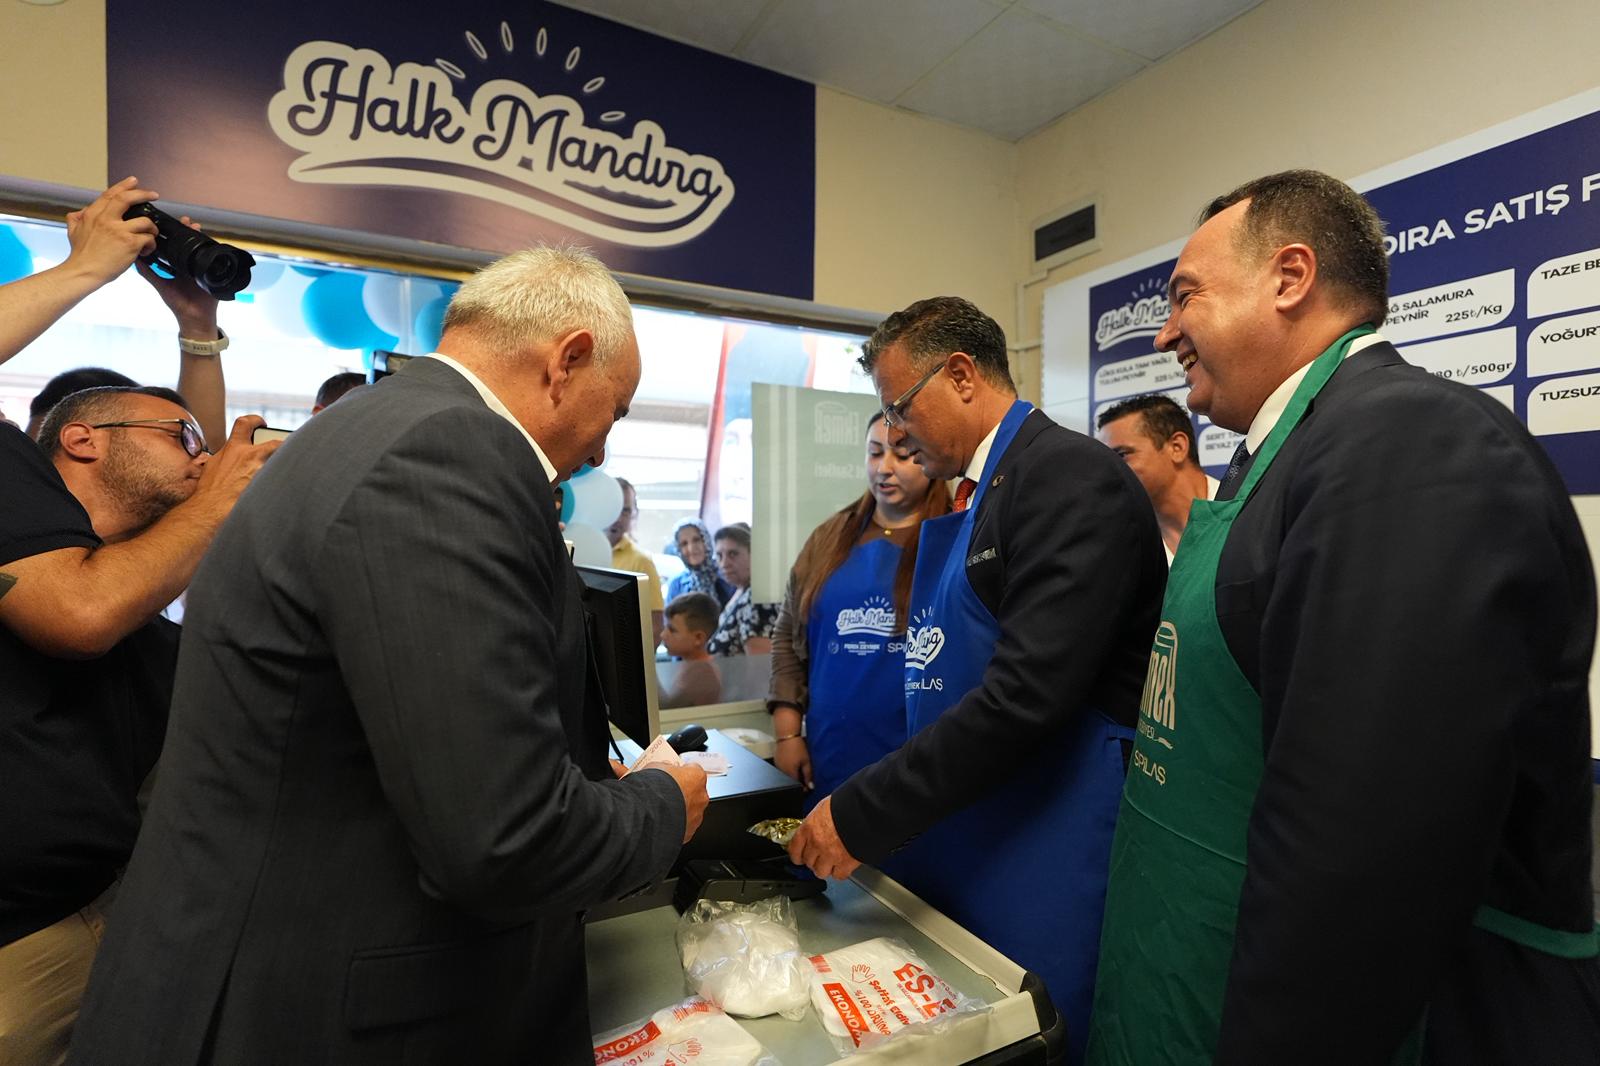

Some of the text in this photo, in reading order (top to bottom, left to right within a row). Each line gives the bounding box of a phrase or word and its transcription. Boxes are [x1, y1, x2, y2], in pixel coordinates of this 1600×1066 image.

[287, 57, 722, 200] Halk Mandıra
[1464, 184, 1571, 234] SATIŞ
[1541, 263, 1581, 280] TAZE
[1402, 288, 1475, 311] SALAMURA
[1098, 301, 1171, 340] Halk Man
[1385, 309, 1430, 326] PEYNİR
